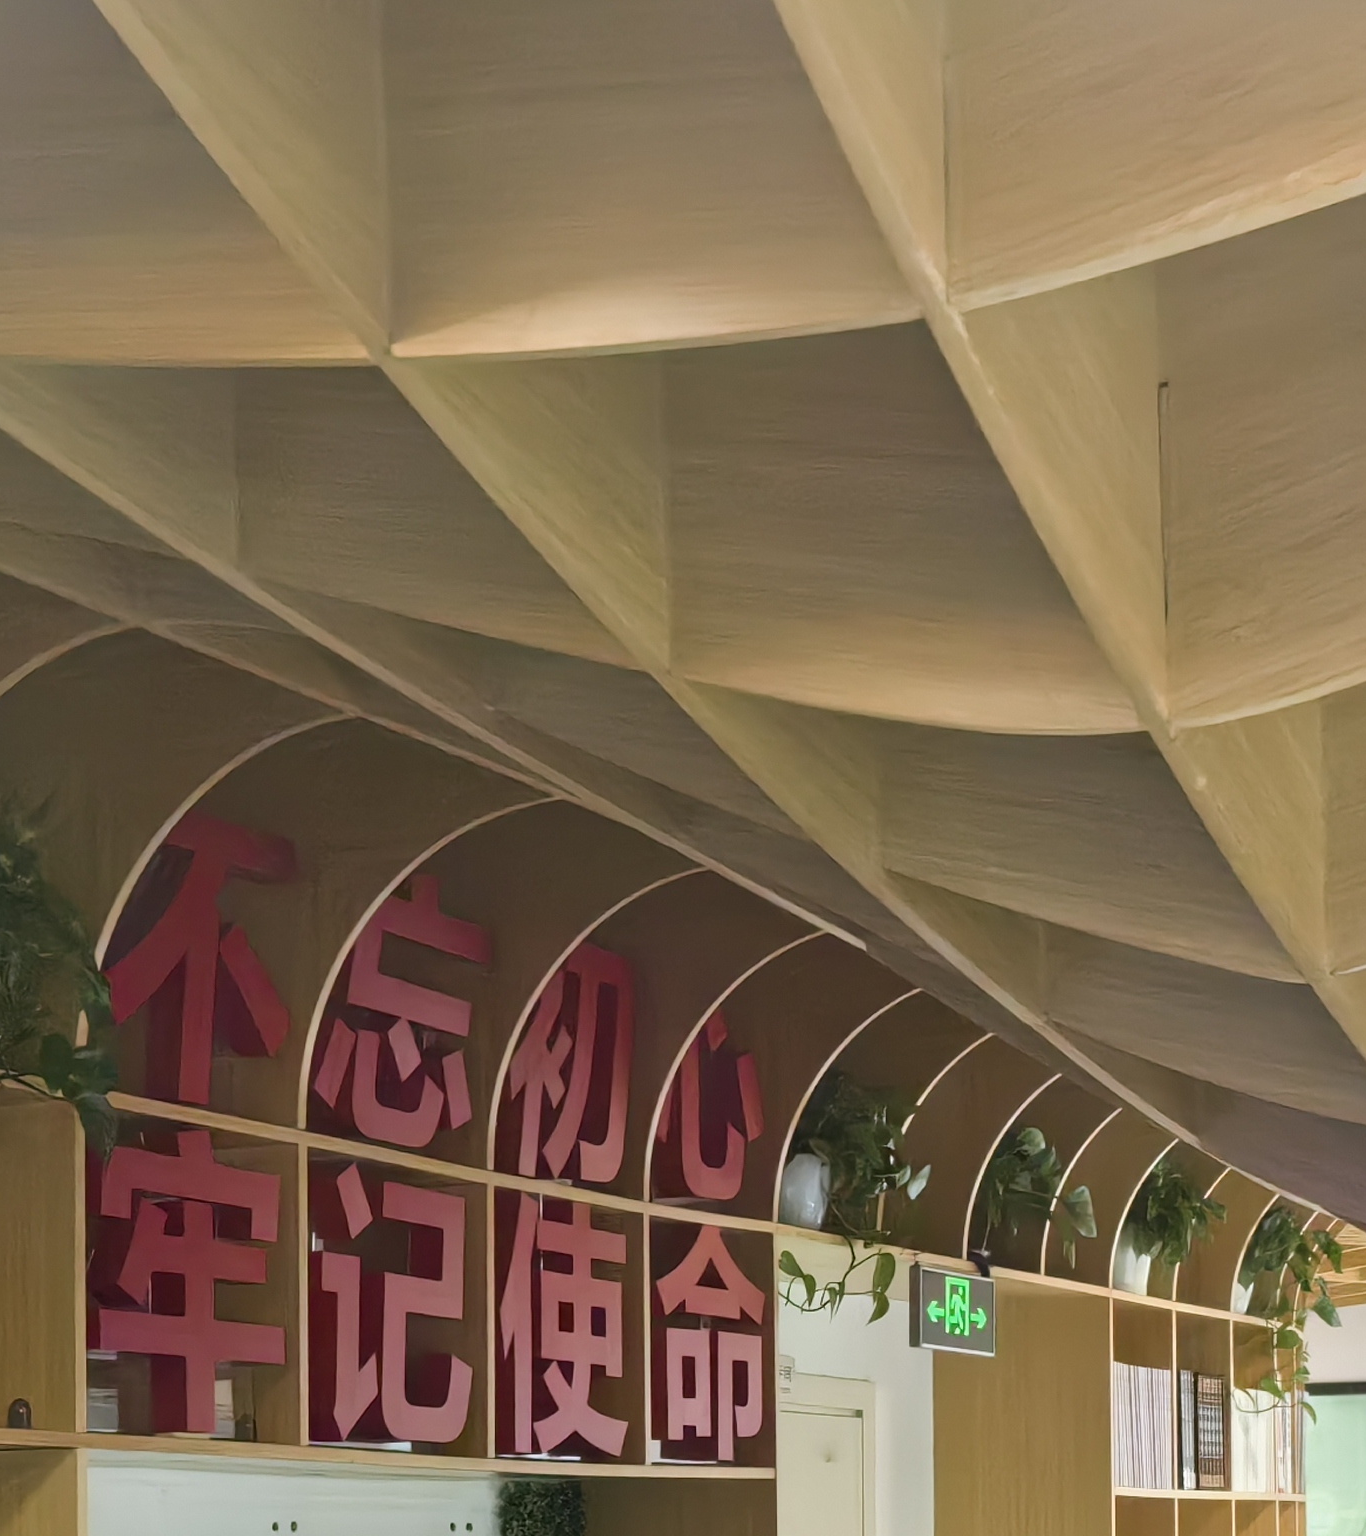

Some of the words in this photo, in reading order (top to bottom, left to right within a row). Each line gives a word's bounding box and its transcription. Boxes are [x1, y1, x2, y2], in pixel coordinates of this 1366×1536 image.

[101, 811, 765, 1201] 不忘初心
[98, 1129, 766, 1462] 牢记使命
